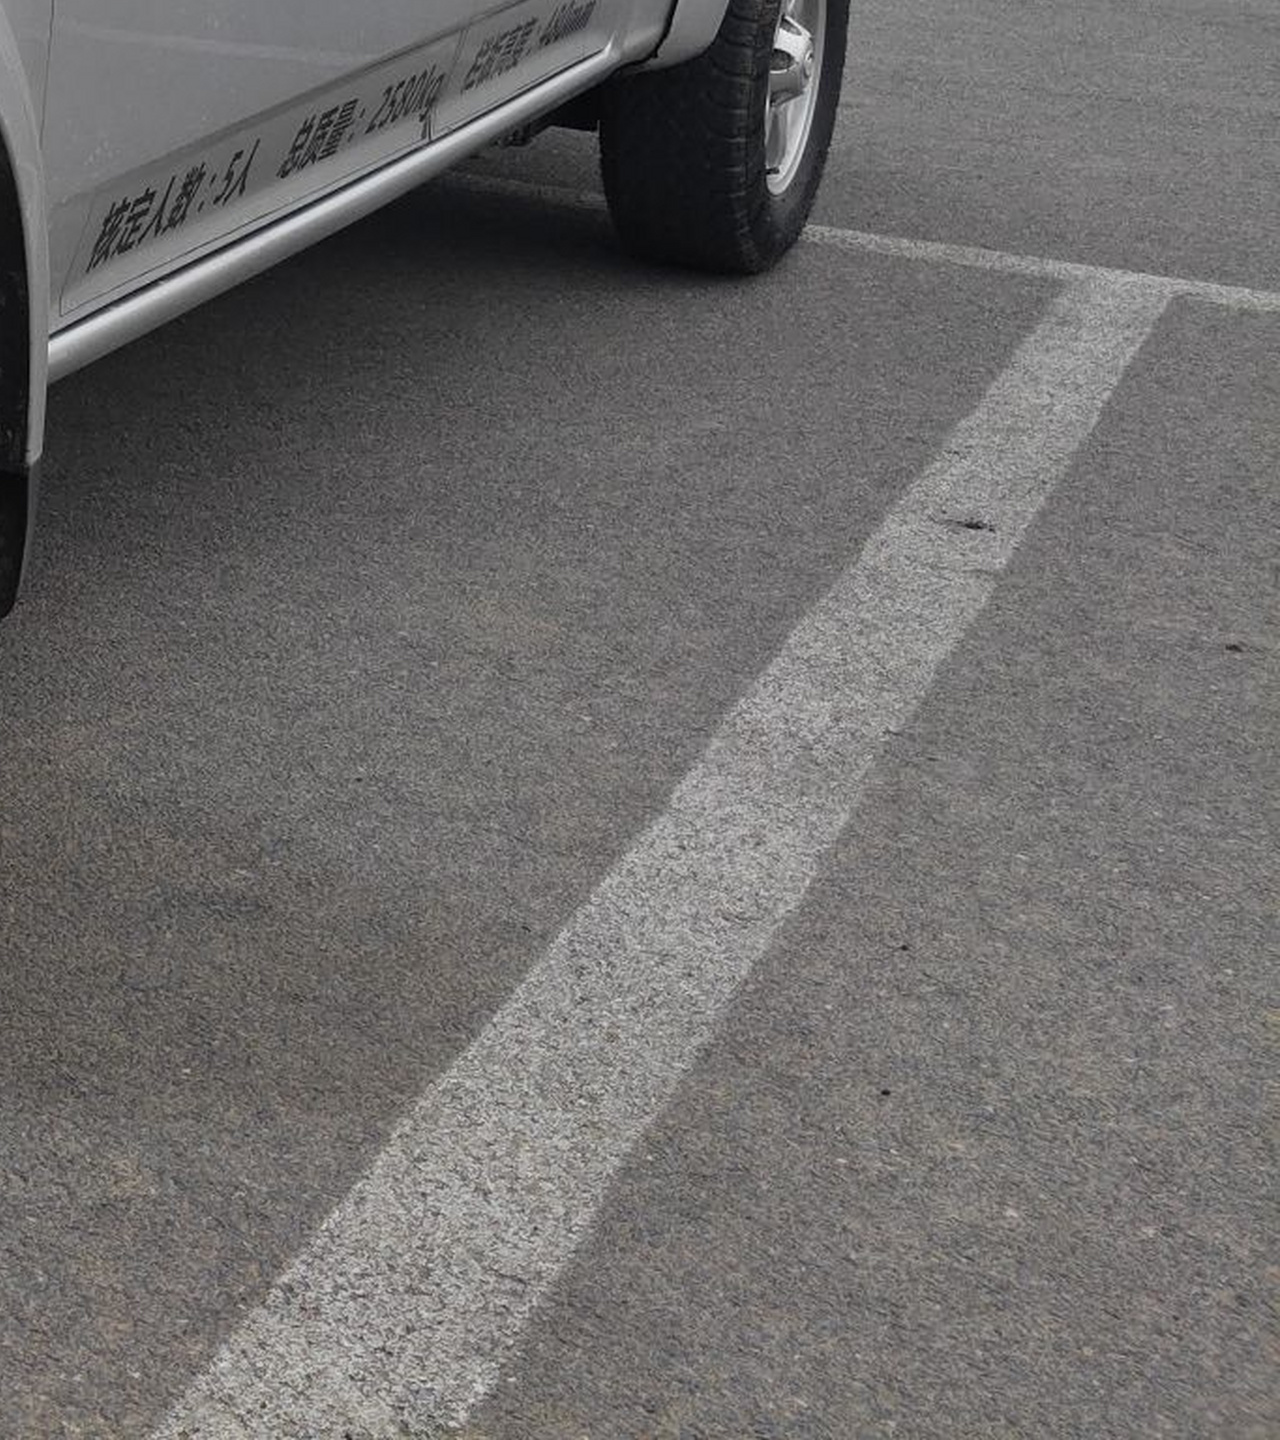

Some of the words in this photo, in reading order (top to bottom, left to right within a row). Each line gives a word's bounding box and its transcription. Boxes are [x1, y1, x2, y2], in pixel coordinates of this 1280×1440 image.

[85, 138, 261, 274] 核定人数：5人
